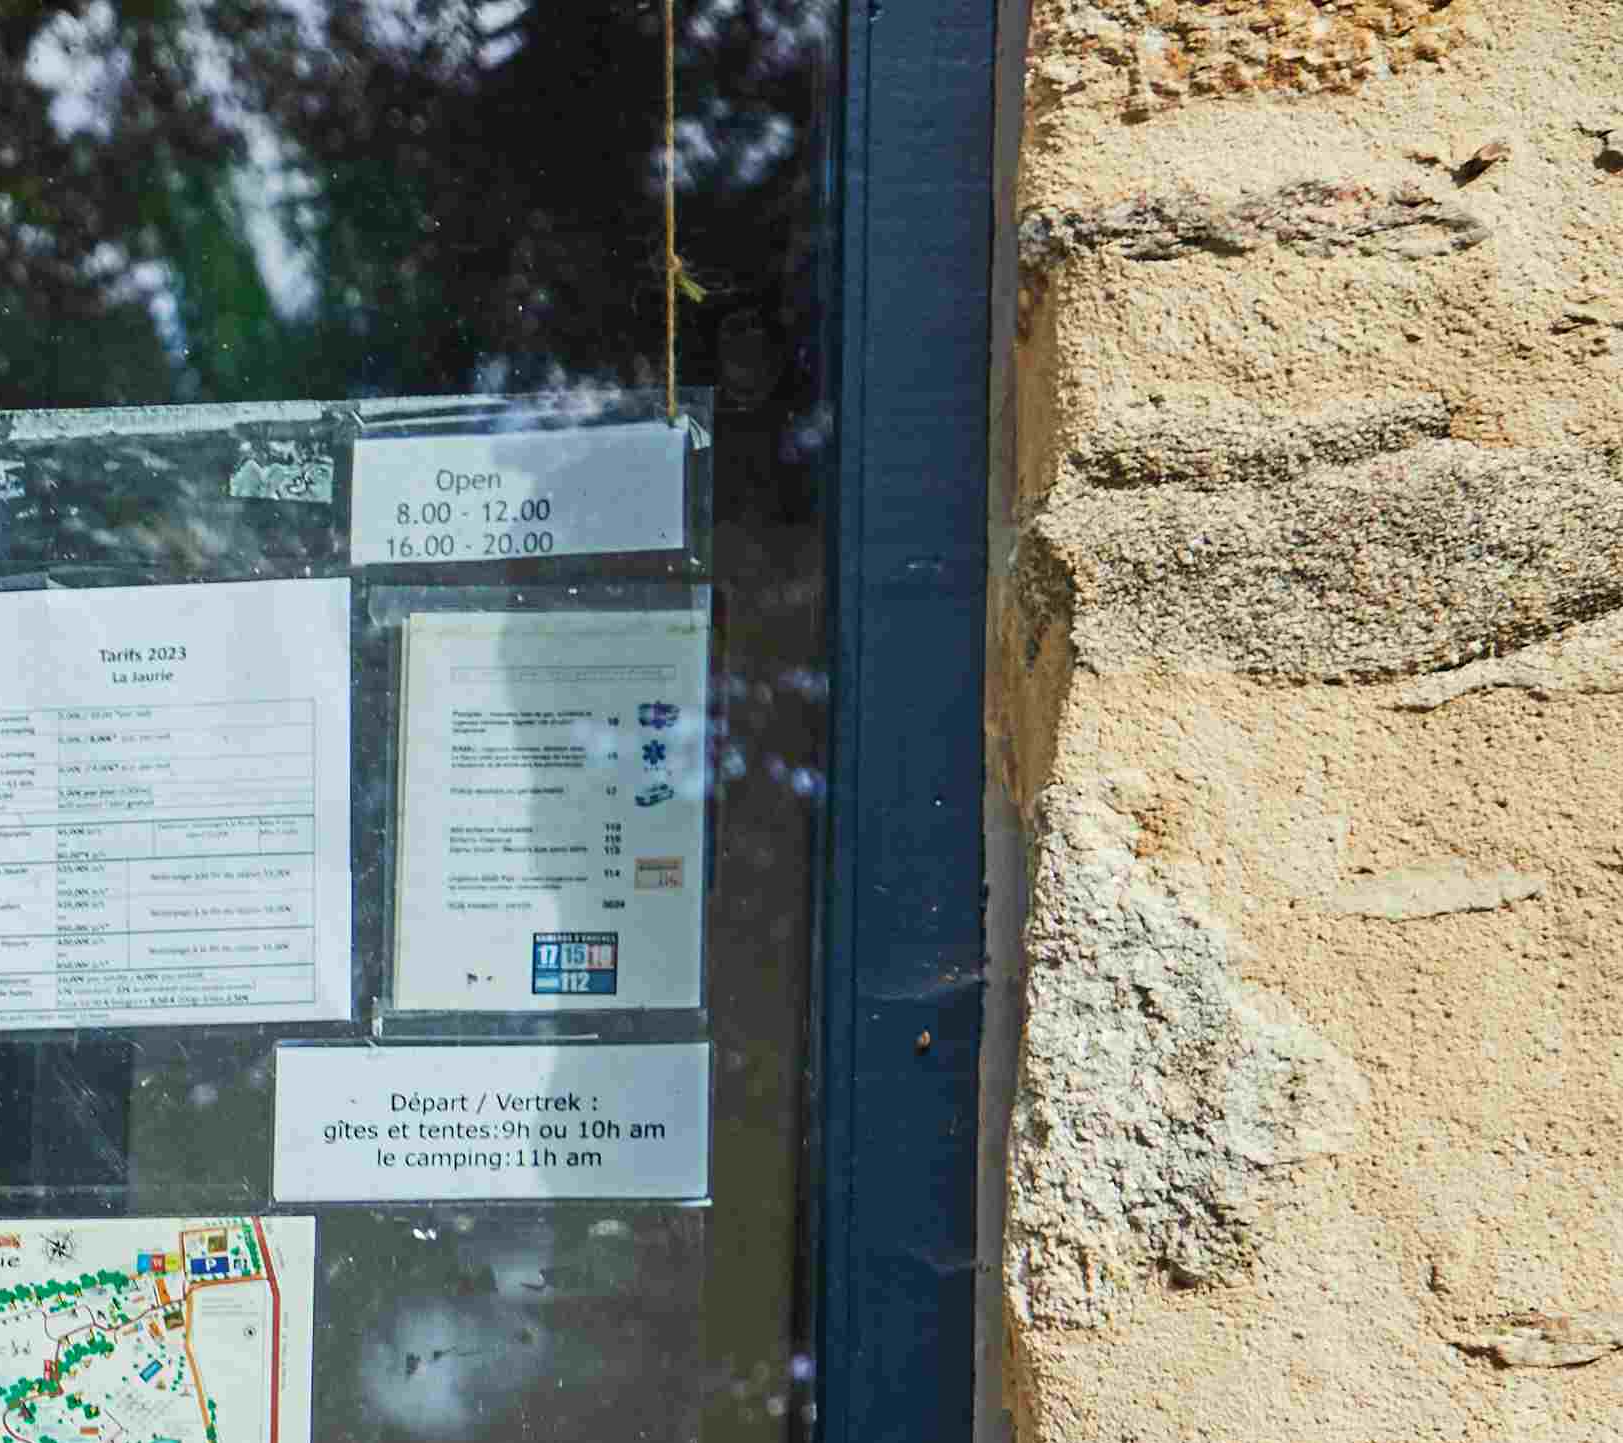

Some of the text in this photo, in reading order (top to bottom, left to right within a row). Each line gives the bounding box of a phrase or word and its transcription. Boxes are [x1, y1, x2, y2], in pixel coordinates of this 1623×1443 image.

[436, 468, 502, 496] Open
[396, 500, 452, 526] 8.00
[482, 498, 552, 522] 12.00
[386, 533, 455, 560] 16.00
[483, 530, 555, 556] 20.00
[98, 645, 188, 664] Tarifs 2023
[111, 668, 174, 685] La Jaurie
[391, 1093, 468, 1117] Départ
[476, 1093, 488, 1115] /
[496, 1092, 581, 1112] Vertrek
[324, 1119, 667, 1143] gîtes et tentes:9h ou 10h am
[377, 1147, 603, 1172] le camping:11h am
